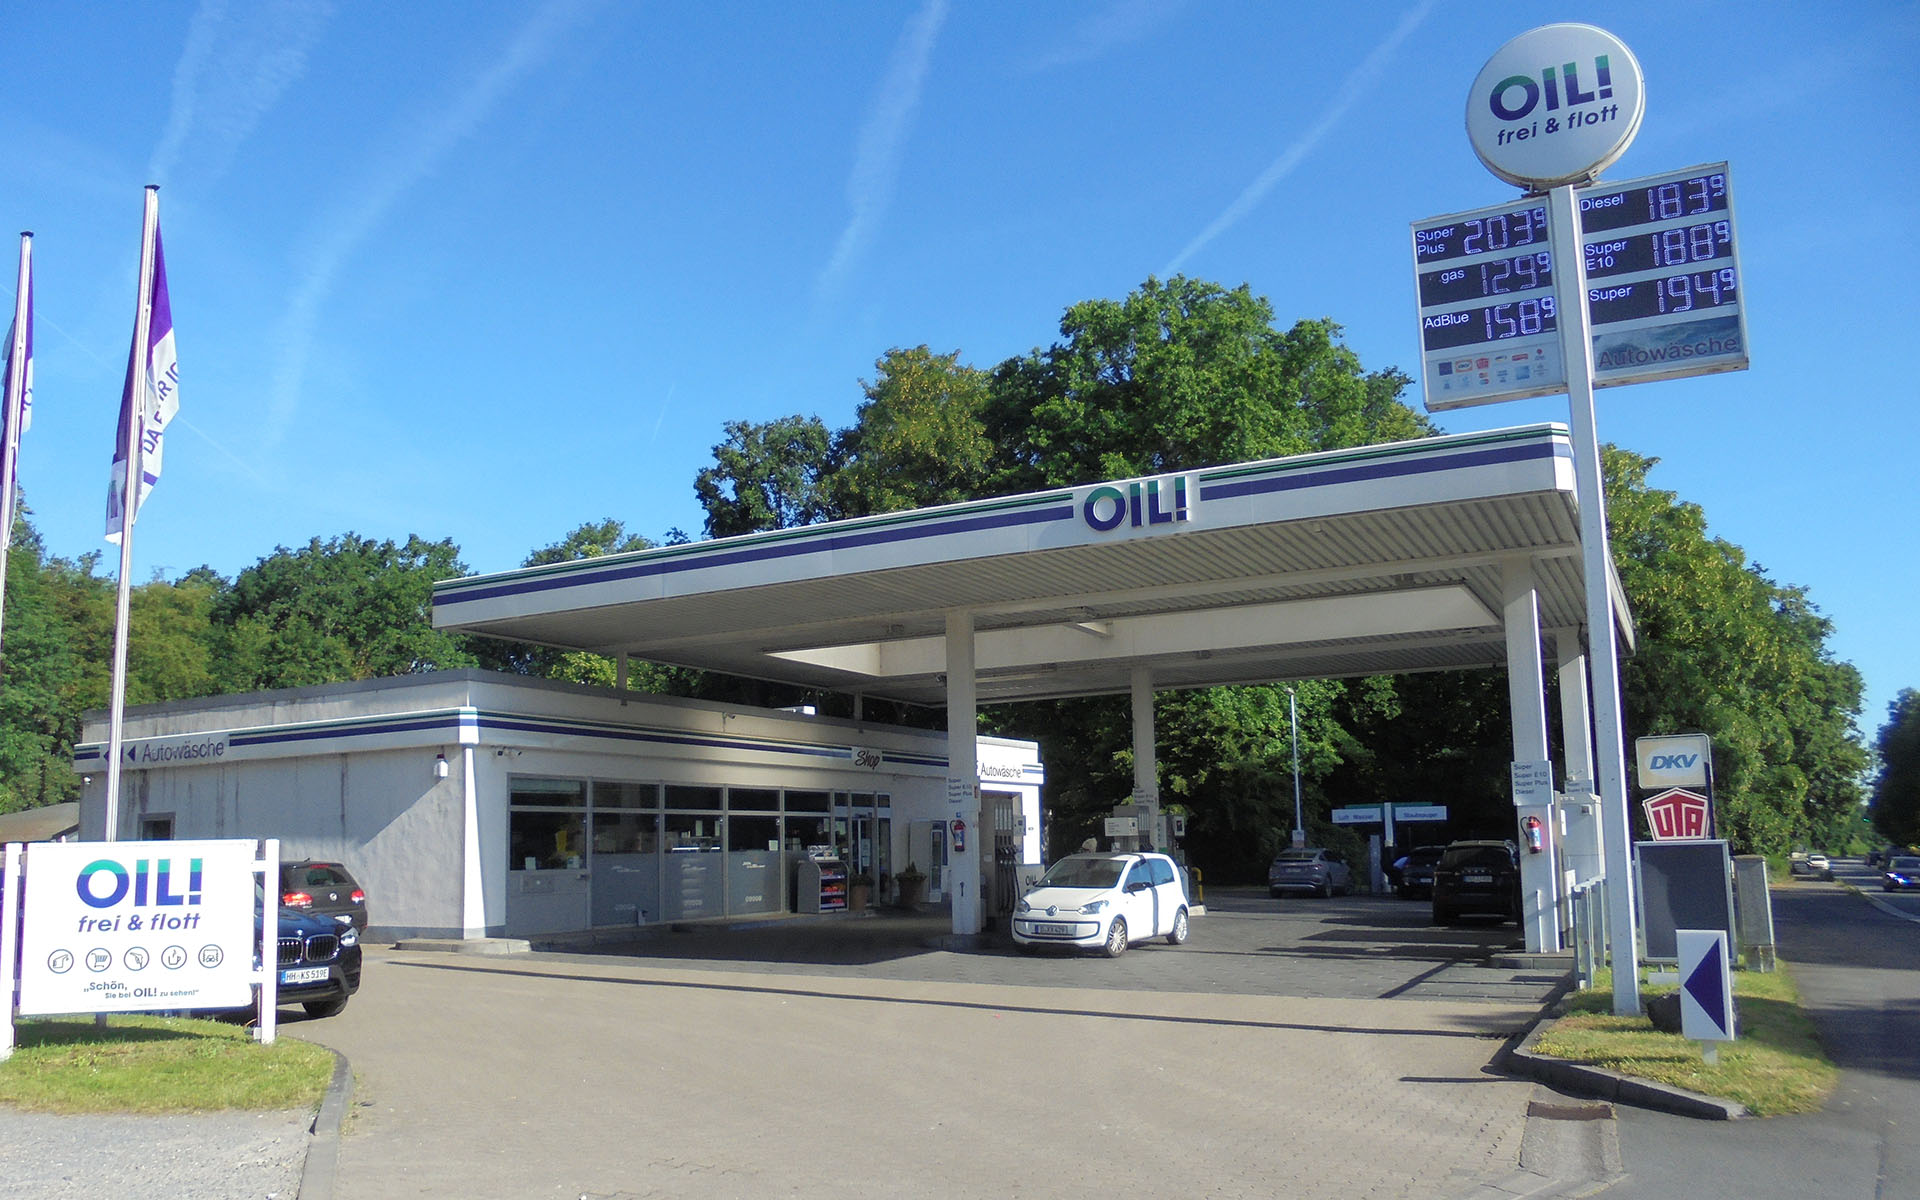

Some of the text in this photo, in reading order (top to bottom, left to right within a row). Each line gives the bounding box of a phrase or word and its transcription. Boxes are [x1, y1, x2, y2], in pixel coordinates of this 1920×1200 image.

[1489, 54, 1613, 121] OIL!
[1497, 104, 1619, 146] frei & flott
[1580, 193, 1625, 212] Diesel
[1416, 226, 1455, 243] Super
[1416, 241, 1446, 256] Plus
[1585, 239, 1627, 257] Super
[1586, 256, 1615, 271] E10
[1440, 269, 1465, 284] gas
[1589, 285, 1632, 302] Super
[1424, 312, 1470, 329] AdBlue
[1599, 337, 1738, 368] Autowäsche
[1084, 476, 1188, 532] OIL!
[142, 737, 225, 763] Autowäsche
[855, 750, 881, 770] Shop
[1650, 753, 1698, 770] DKV
[980, 762, 1022, 779] Autowäsche
[1649, 798, 1707, 839] UTA
[76, 858, 203, 909] OIL!
[78, 912, 202, 933] frei & flott
[83, 980, 128, 993] „Schön,
[133, 987, 157, 998] OIL!
